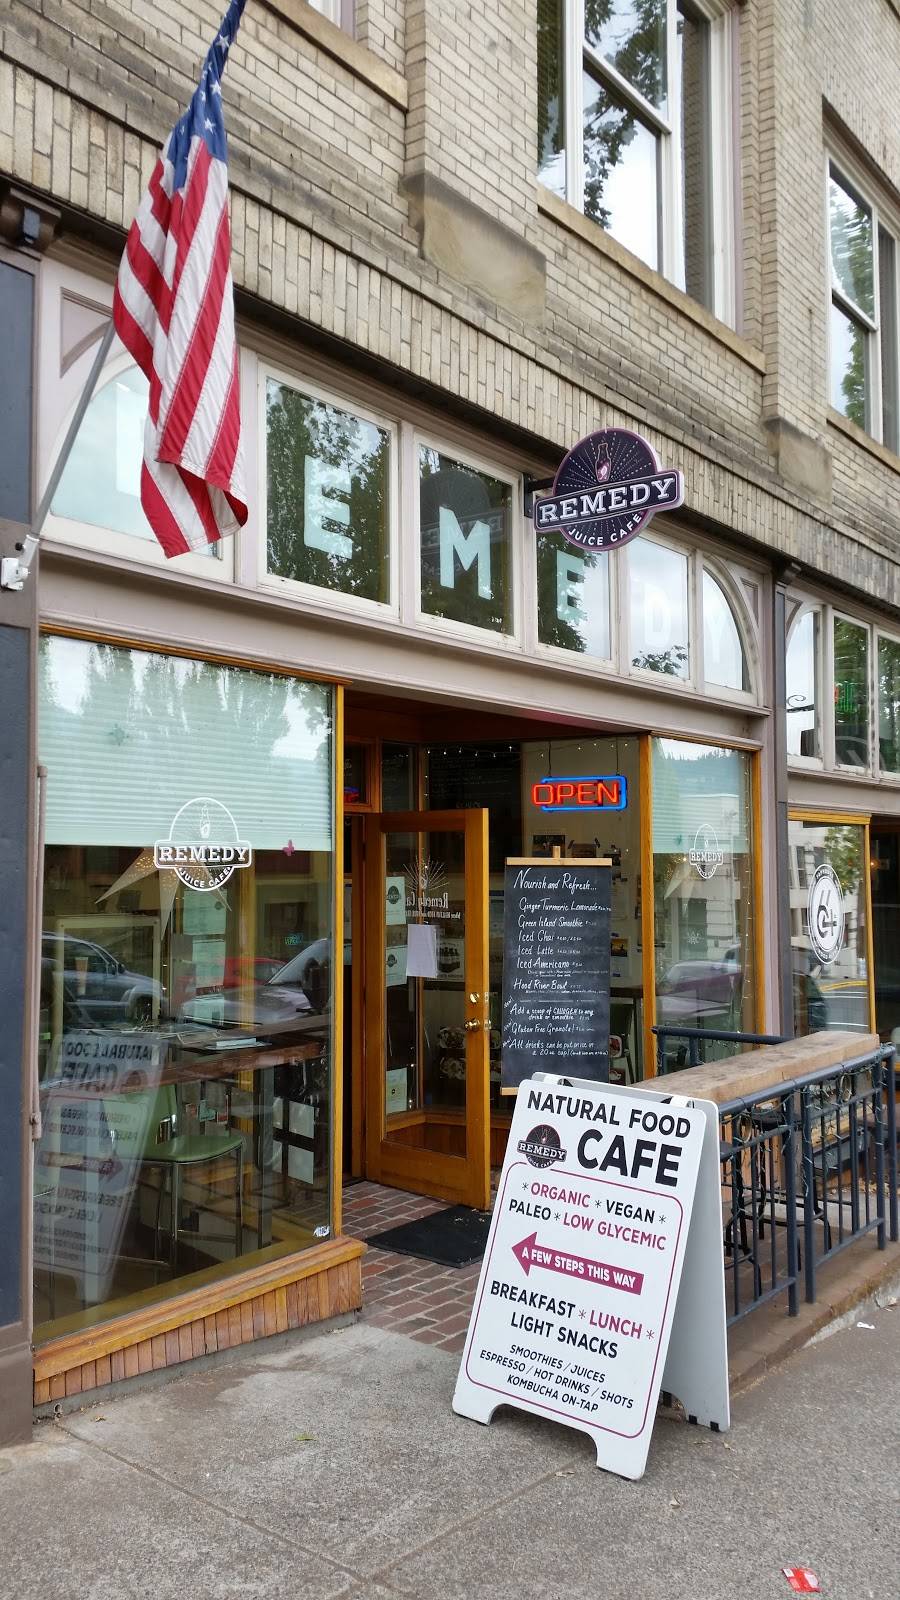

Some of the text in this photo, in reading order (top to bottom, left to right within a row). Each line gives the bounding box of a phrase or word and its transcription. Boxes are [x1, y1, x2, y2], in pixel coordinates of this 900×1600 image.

[539, 478, 674, 523] REMEDY
[568, 513, 642, 546] JUICE CAFE
[532, 782, 619, 806] OPEN
[159, 846, 250, 862] REMEDY
[690, 851, 722, 862] REMEDY
[180, 868, 231, 888] JUICE CAFE
[513, 867, 546, 889] Nourish
[519, 896, 541, 913] Ginger
[540, 897, 569, 911] Turmeric
[517, 914, 537, 929] Green
[538, 916, 557, 927] Island
[558, 916, 583, 928] Smoothie
[518, 930, 534, 942] Iced
[537, 929, 555, 942] Chai
[517, 945, 532, 956] Iced
[537, 945, 554, 955] Latte
[516, 957, 532, 969] Iced
[532, 957, 570, 969] Americano
[513, 978, 531, 991] Hood
[533, 979, 549, 989] River
[551, 979, 568, 989] Bowl
[510, 1003, 525, 1016] Add
[511, 1022, 533, 1034] Gluten
[534, 1023, 546, 1033] Free
[509, 1038, 523, 1049] All
[525, 1039, 544, 1049] drinks
[526, 1089, 691, 1139] NATURAL FOOD
[519, 1142, 565, 1160] REMEDY
[576, 1128, 683, 1188] CAFE
[530, 1182, 656, 1224] ORGANIC VEGAN
[508, 1198, 667, 1251] PALEO LOW GLYCEMIC
[521, 1247, 636, 1289] A FEW STEPS THIS WAY
[490, 1280, 643, 1340] BREAKFAST LUNCH
[510, 1311, 619, 1359] LIGHT SNACKS
[509, 1344, 564, 1370] SMOOTHIES
[570, 1364, 606, 1384] JUICES
[479, 1349, 526, 1373] ESPRESSO
[534, 1367, 553, 1383] HOT
[555, 1376, 591, 1395] DRINKS
[600, 1390, 634, 1410] SHOTS
[507, 1374, 599, 1413] KOMBUCHA ON-TAP
